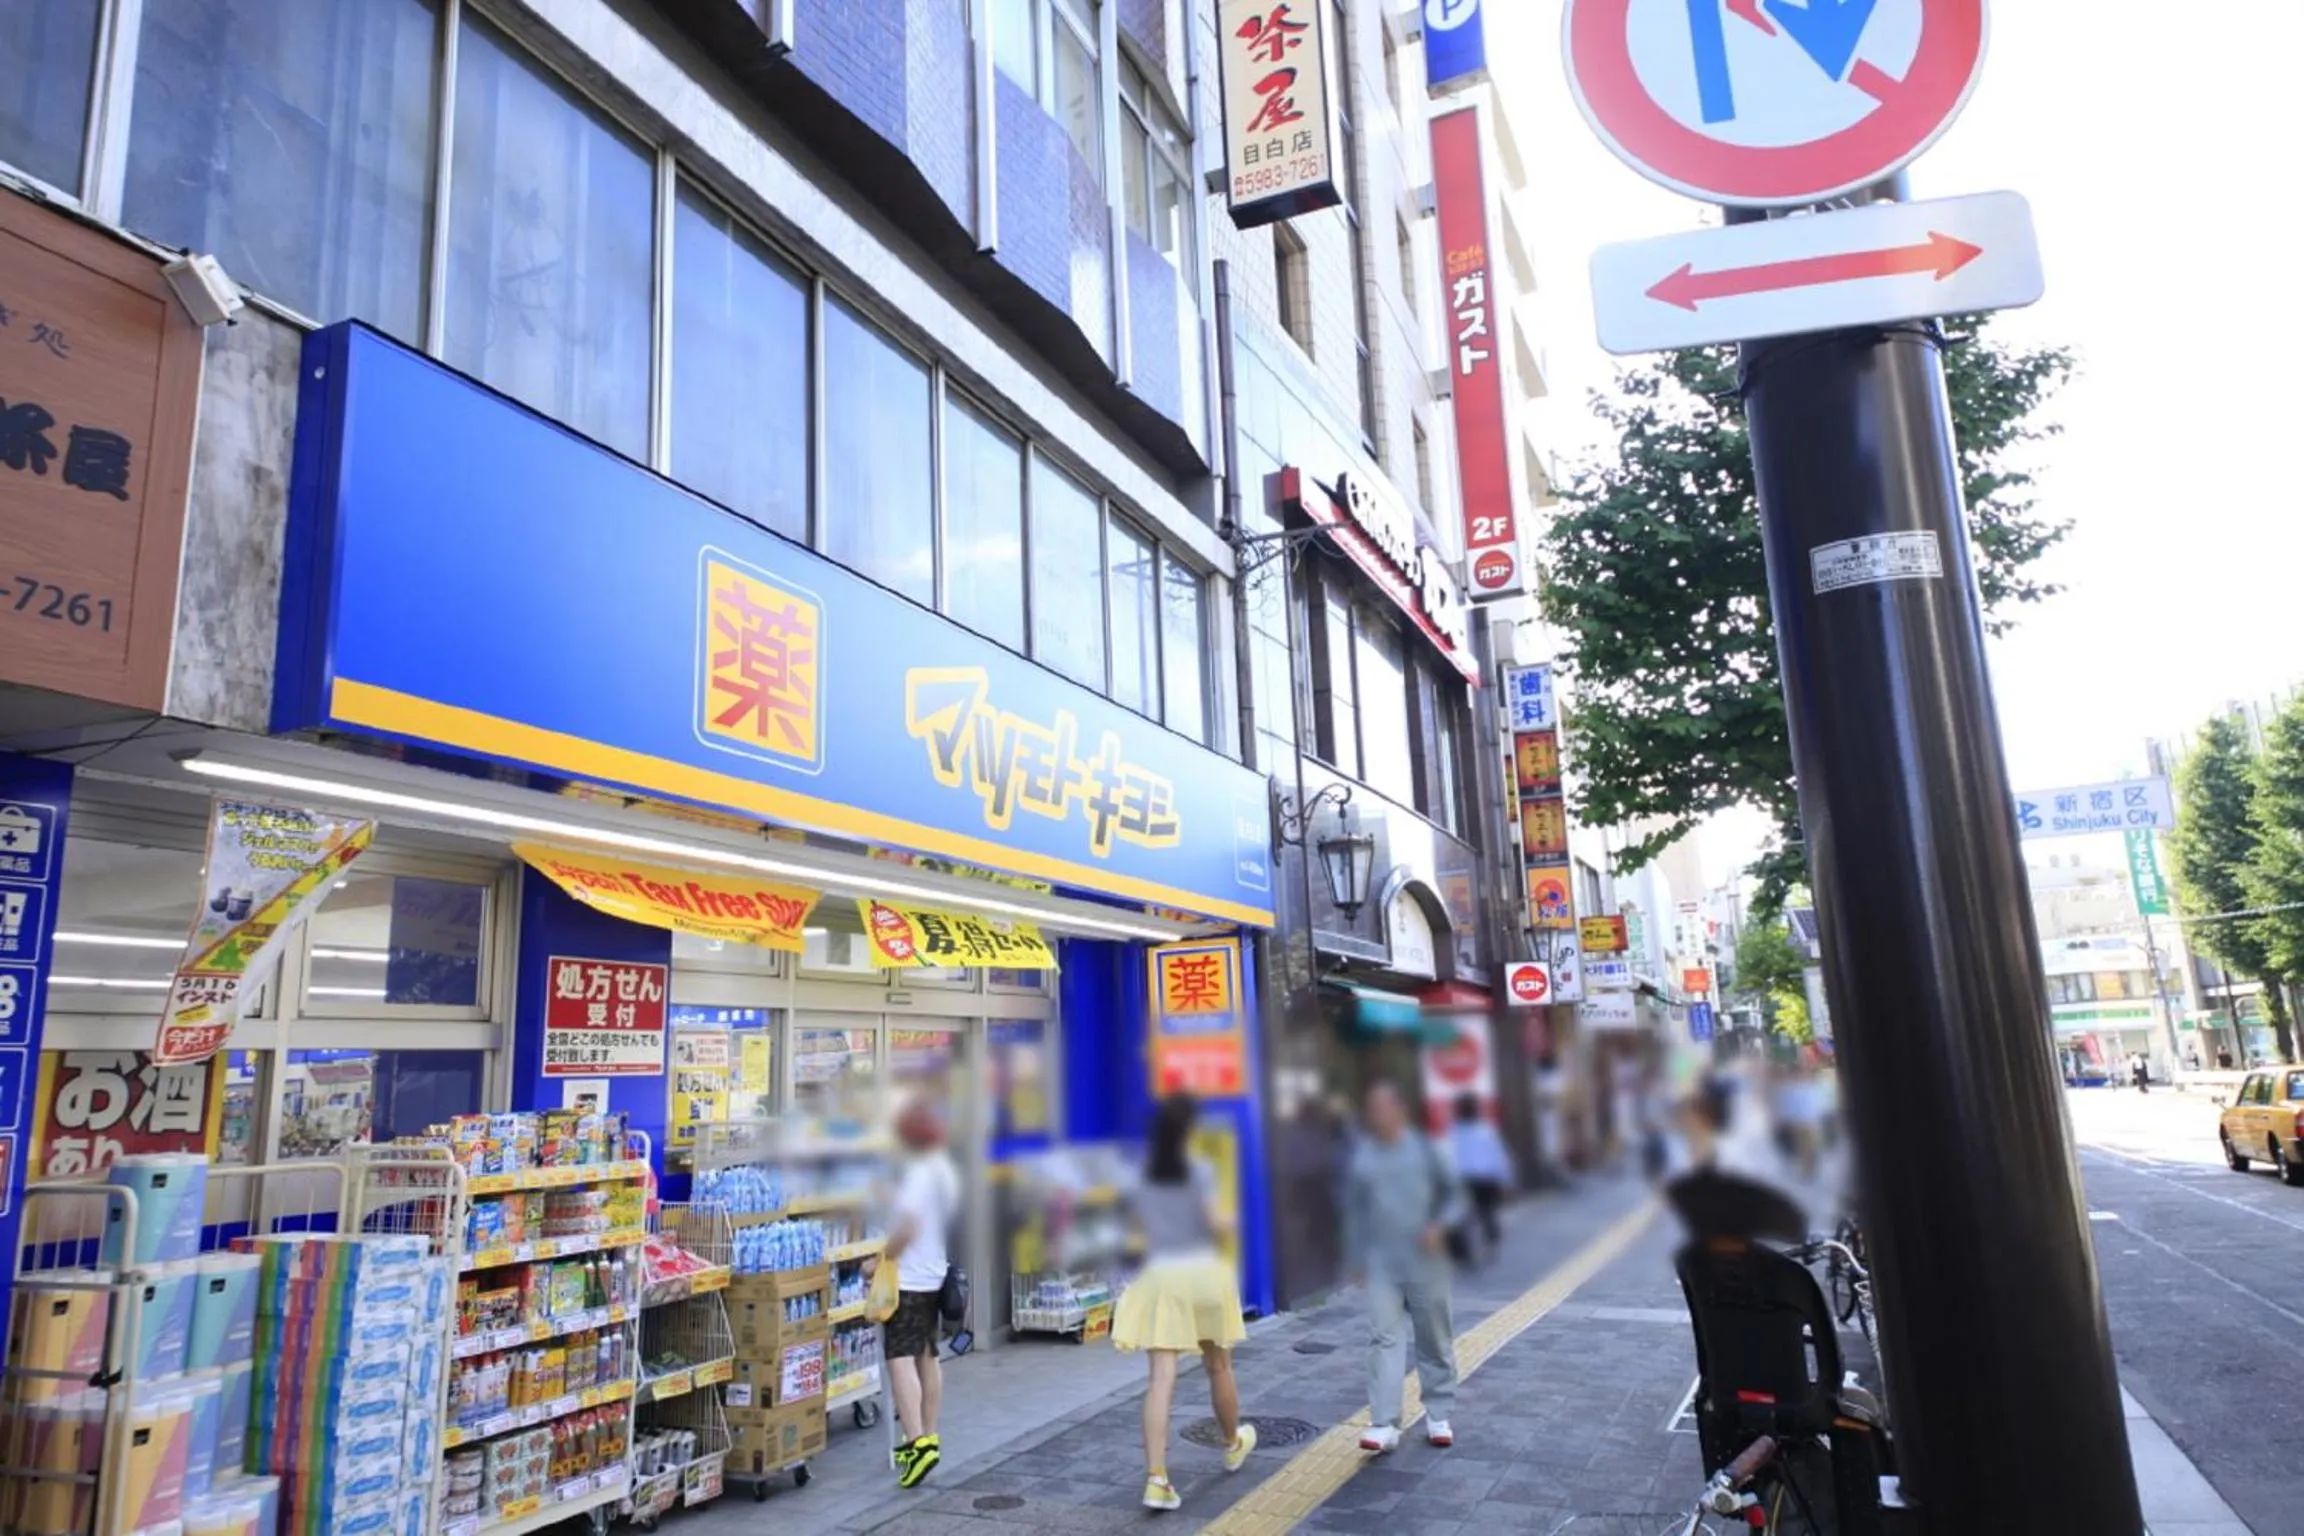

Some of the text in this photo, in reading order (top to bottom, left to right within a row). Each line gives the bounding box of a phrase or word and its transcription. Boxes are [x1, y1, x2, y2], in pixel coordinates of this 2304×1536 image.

[1243, 129, 1313, 166] 目白店
[1452, 271, 1489, 376] ガスト
[1472, 516, 1508, 541] 2F
[711, 578, 812, 754] 薬
[905, 666, 1182, 859] マツモトキヨシ
[2053, 785, 2149, 814] 新宿区
[2052, 809, 2159, 833] Shinjuku City
[621, 871, 695, 913] Tax
[556, 962, 663, 1002] 処方せん
[1168, 955, 1221, 1012] 薬
[587, 1003, 636, 1027] 受付
[55, 1050, 207, 1134] お酒
